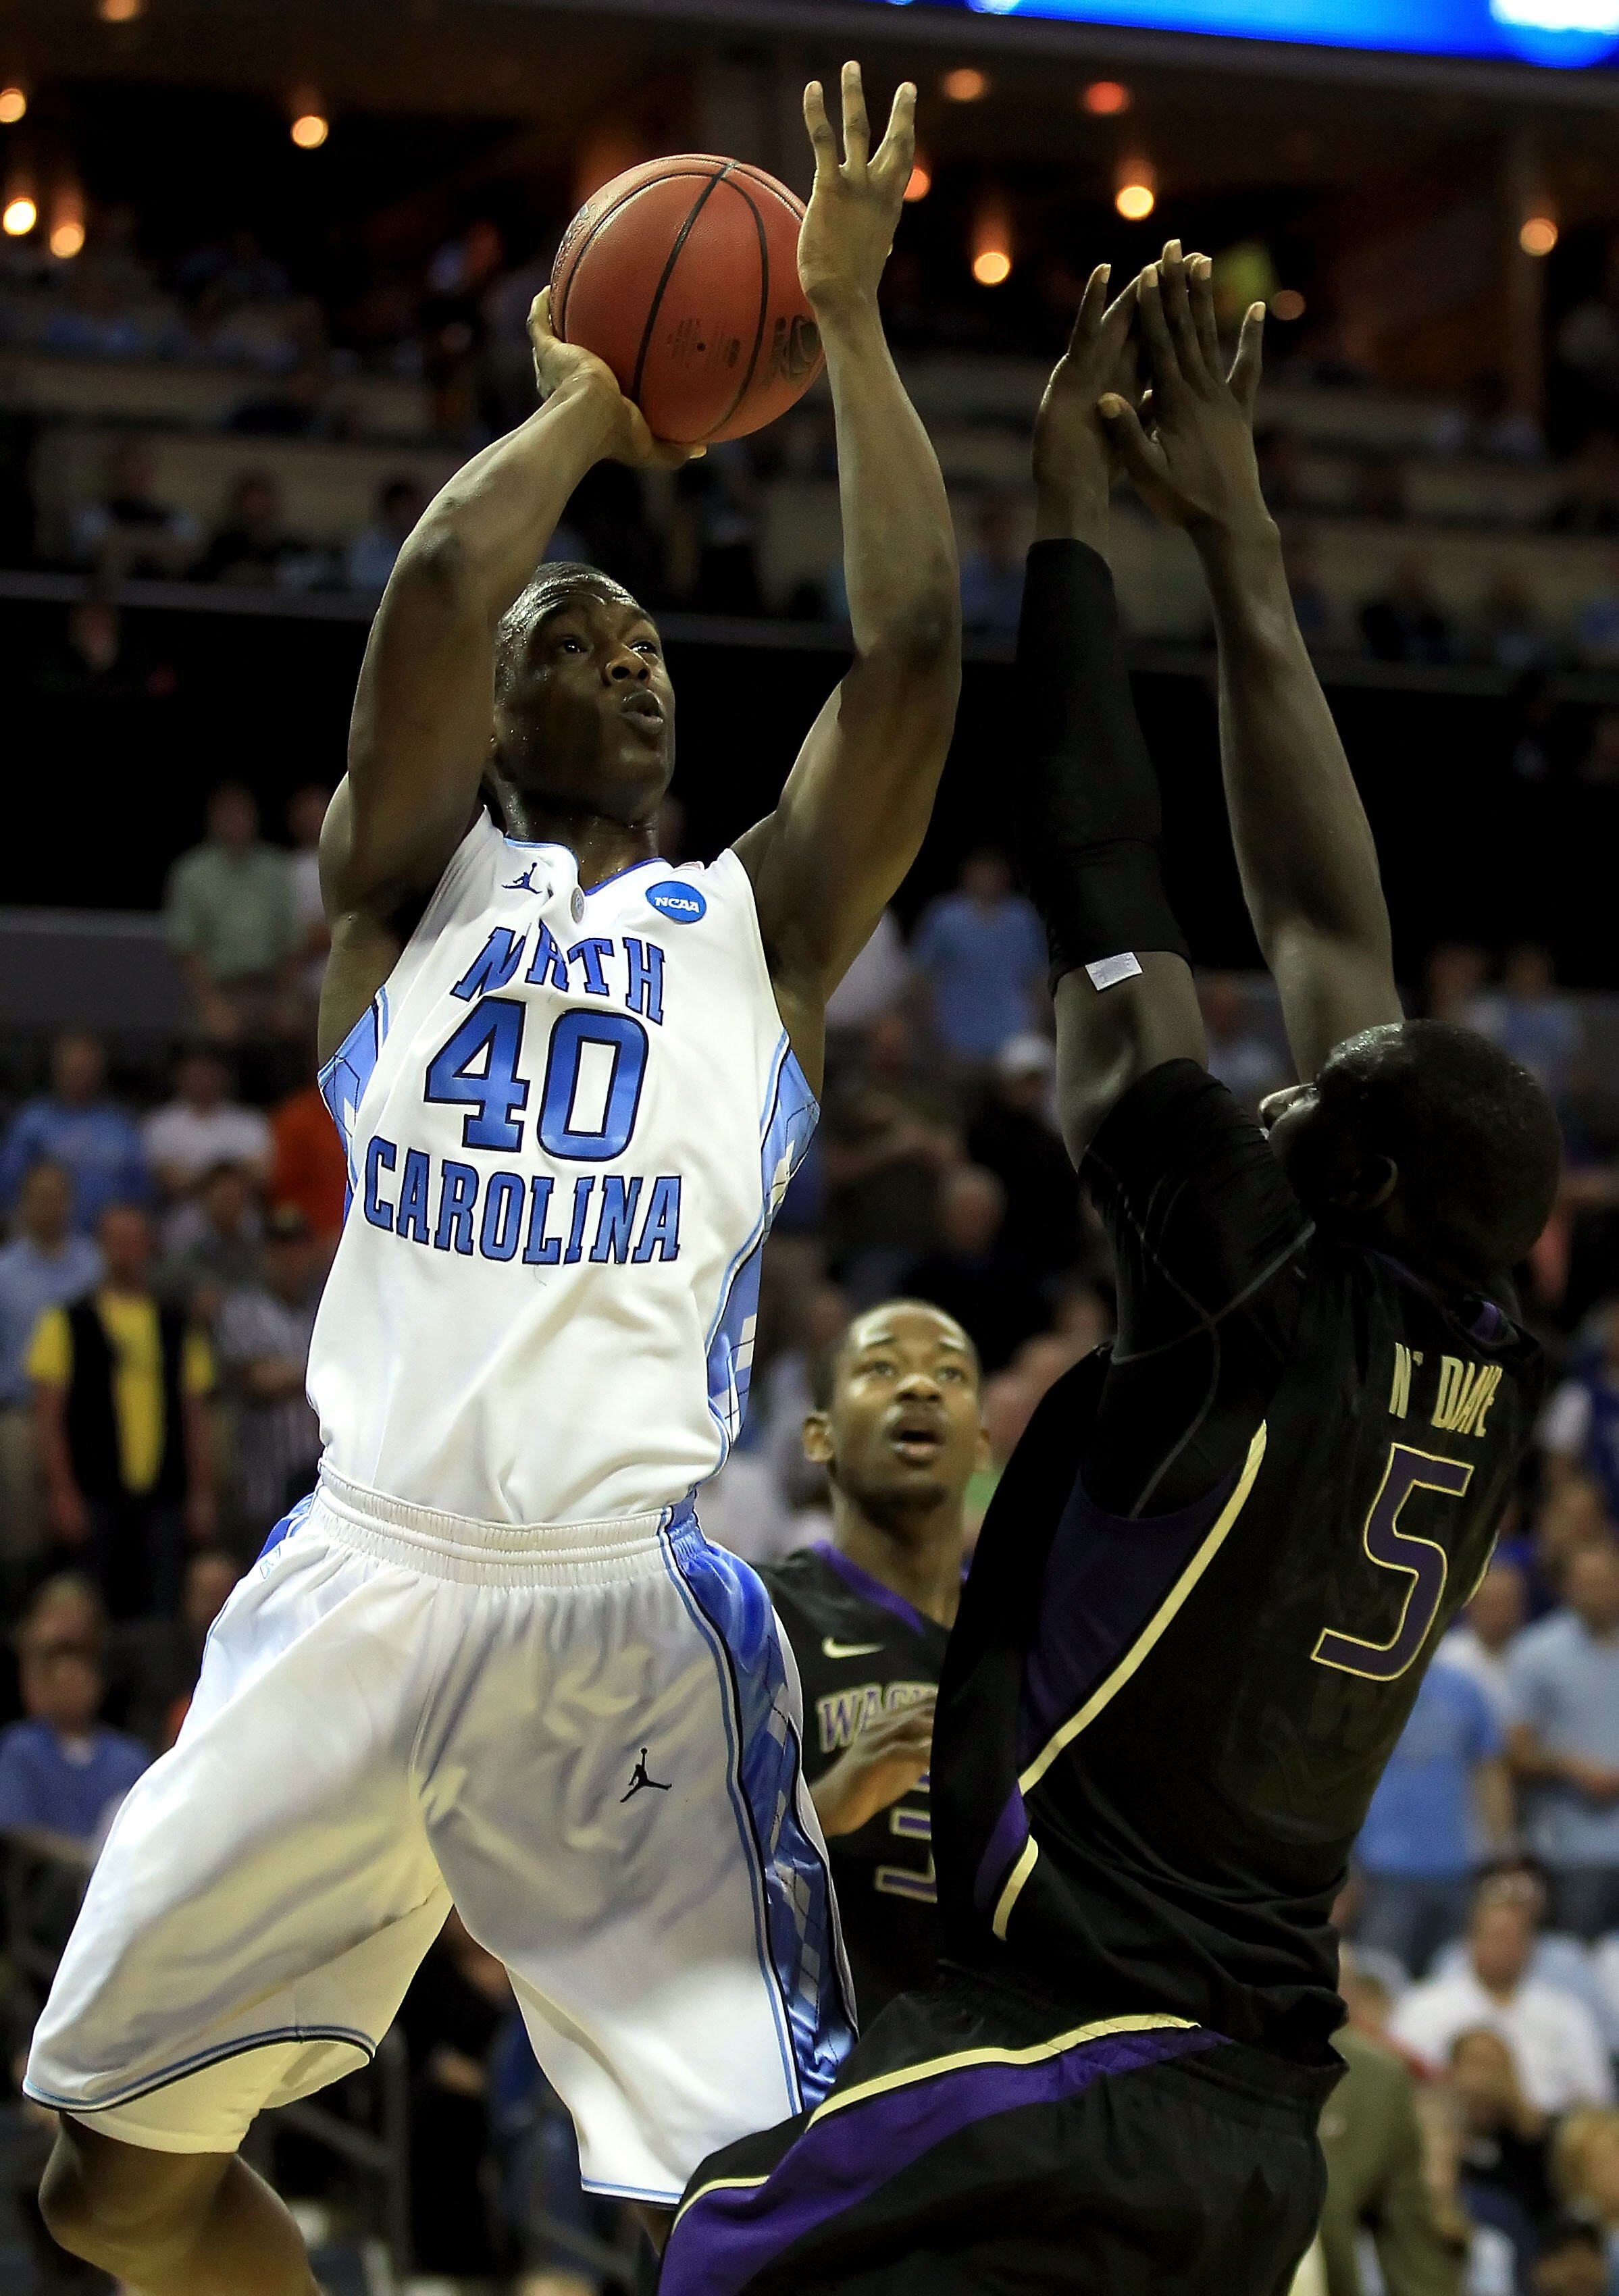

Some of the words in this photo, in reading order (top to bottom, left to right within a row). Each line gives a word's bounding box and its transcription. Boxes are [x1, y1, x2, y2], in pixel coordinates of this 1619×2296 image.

[654, 897, 700, 913] NCAA
[423, 996, 649, 1162] 40
[363, 1135, 682, 1265] CAROLINA
[1311, 1442, 1474, 1681] 5
